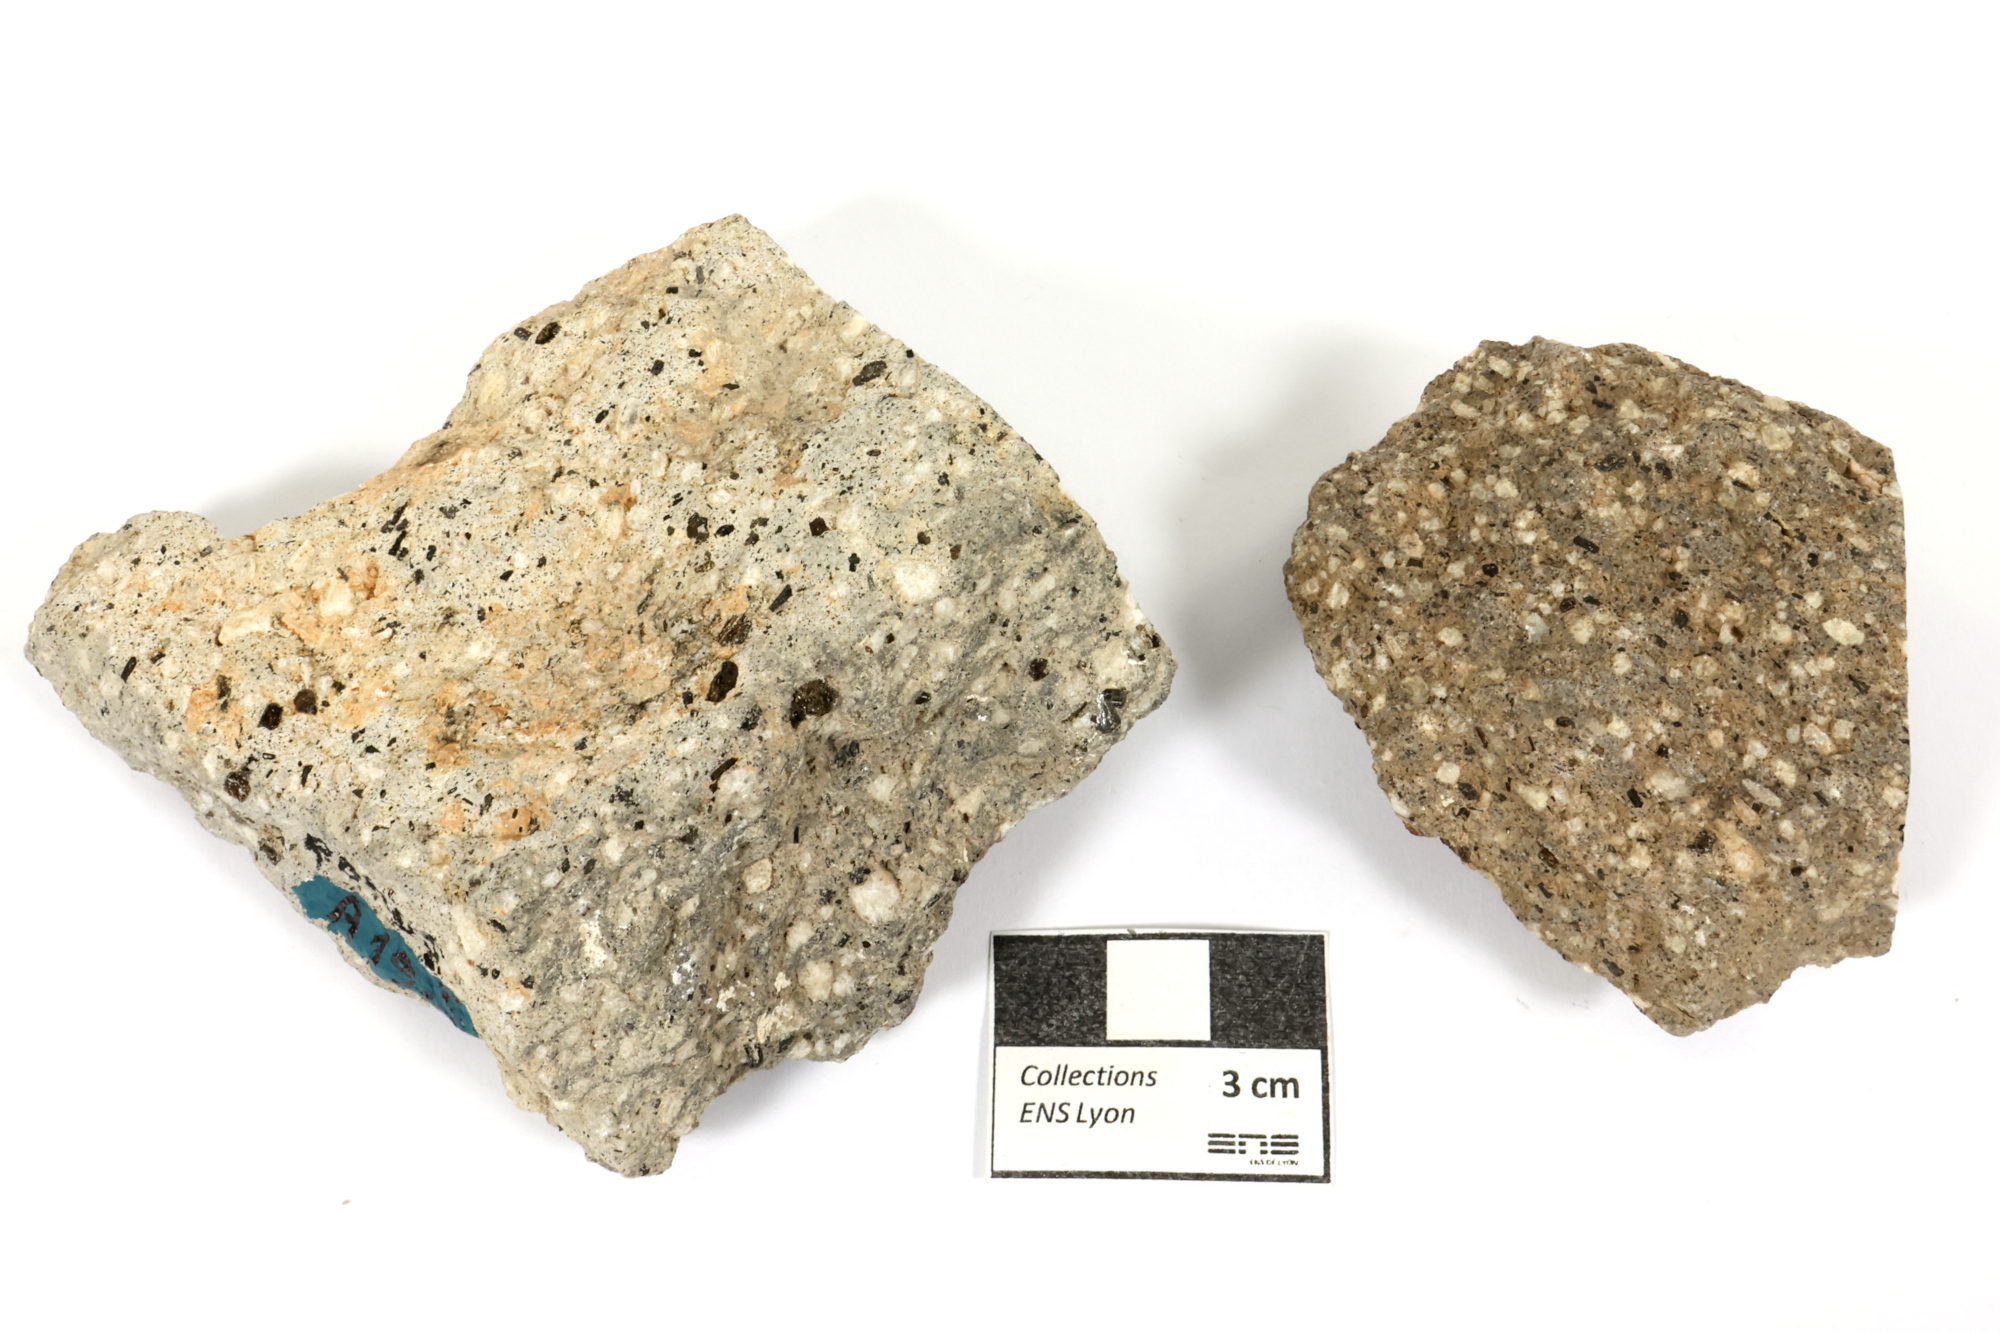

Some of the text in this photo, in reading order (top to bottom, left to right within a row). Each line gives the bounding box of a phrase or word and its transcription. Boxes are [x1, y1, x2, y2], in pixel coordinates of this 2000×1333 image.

[1020, 1064, 1157, 1087] Collections
[1222, 1070, 1300, 1099] 3 cm
[1019, 1102, 1135, 1129] ENS Lyon
